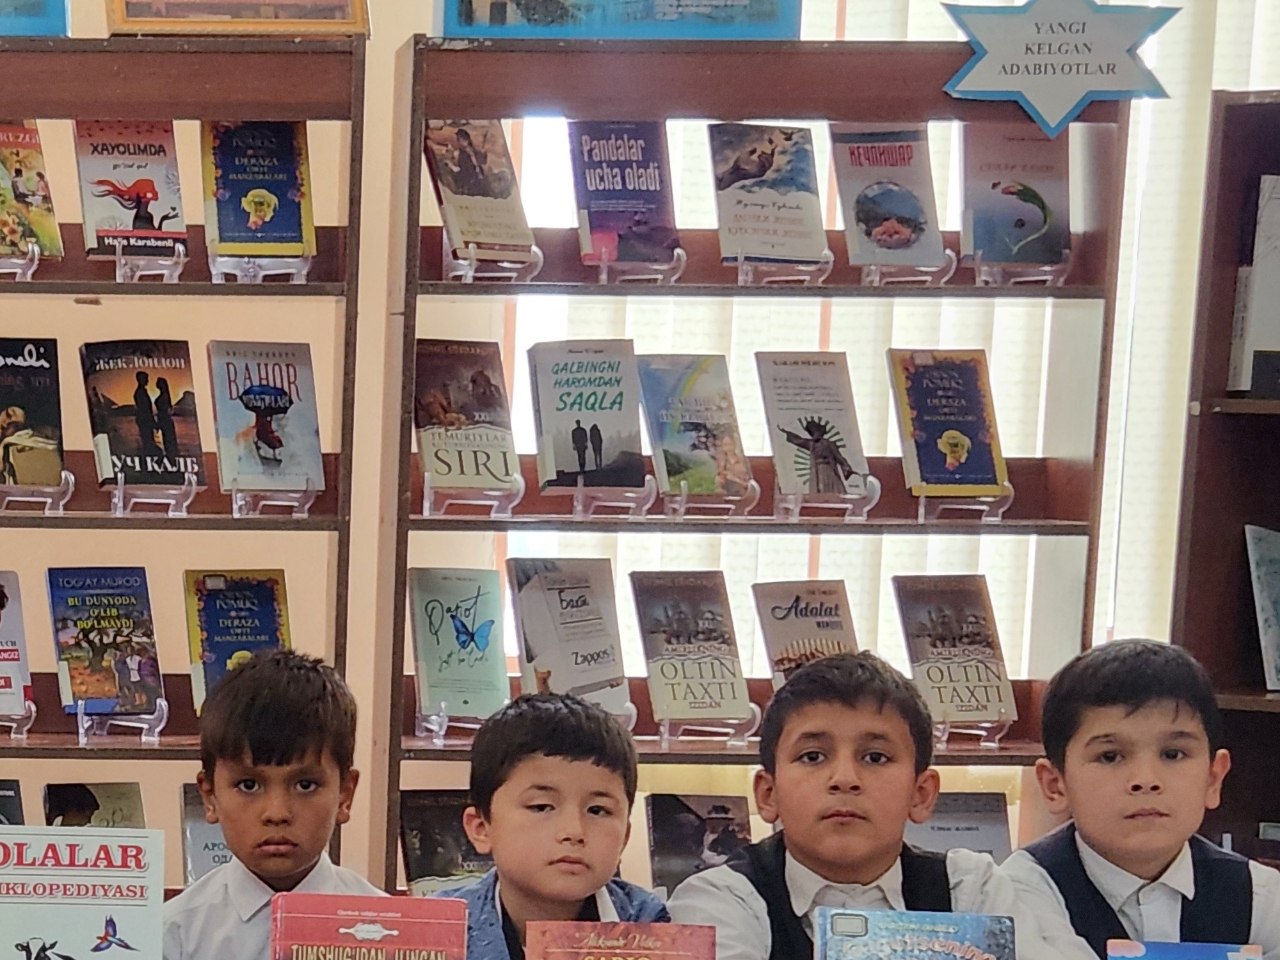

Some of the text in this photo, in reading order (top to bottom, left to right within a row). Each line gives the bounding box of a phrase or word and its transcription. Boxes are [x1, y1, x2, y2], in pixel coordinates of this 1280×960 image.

[1034, 22, 1087, 35] YANGI
[1024, 42, 1093, 55] KELGAN
[998, 63, 1117, 76] ADABIYOTLAR
[90, 143, 167, 157] XAYOLIMDA
[581, 134, 645, 162] Pandalar
[586, 162, 660, 191] ucha oladi
[128, 357, 186, 369] ЛОНДОН
[552, 361, 621, 376] QALBINGNI
[226, 361, 302, 402] BAHOR
[553, 376, 622, 389] HAROMDAN
[556, 390, 623, 412] SAQLA
[431, 431, 508, 442] TEMURIYLAR
[434, 449, 515, 484] SIRI
[67, 596, 137, 606] BU DUNYODA
[90, 608, 119, 617] O'LIB
[571, 649, 610, 666] Zappos
[660, 659, 736, 681] OLTIN
[926, 664, 1003, 685] OLTIN
[668, 681, 737, 701] TAXTI
[931, 685, 1004, 704] TAXTI
